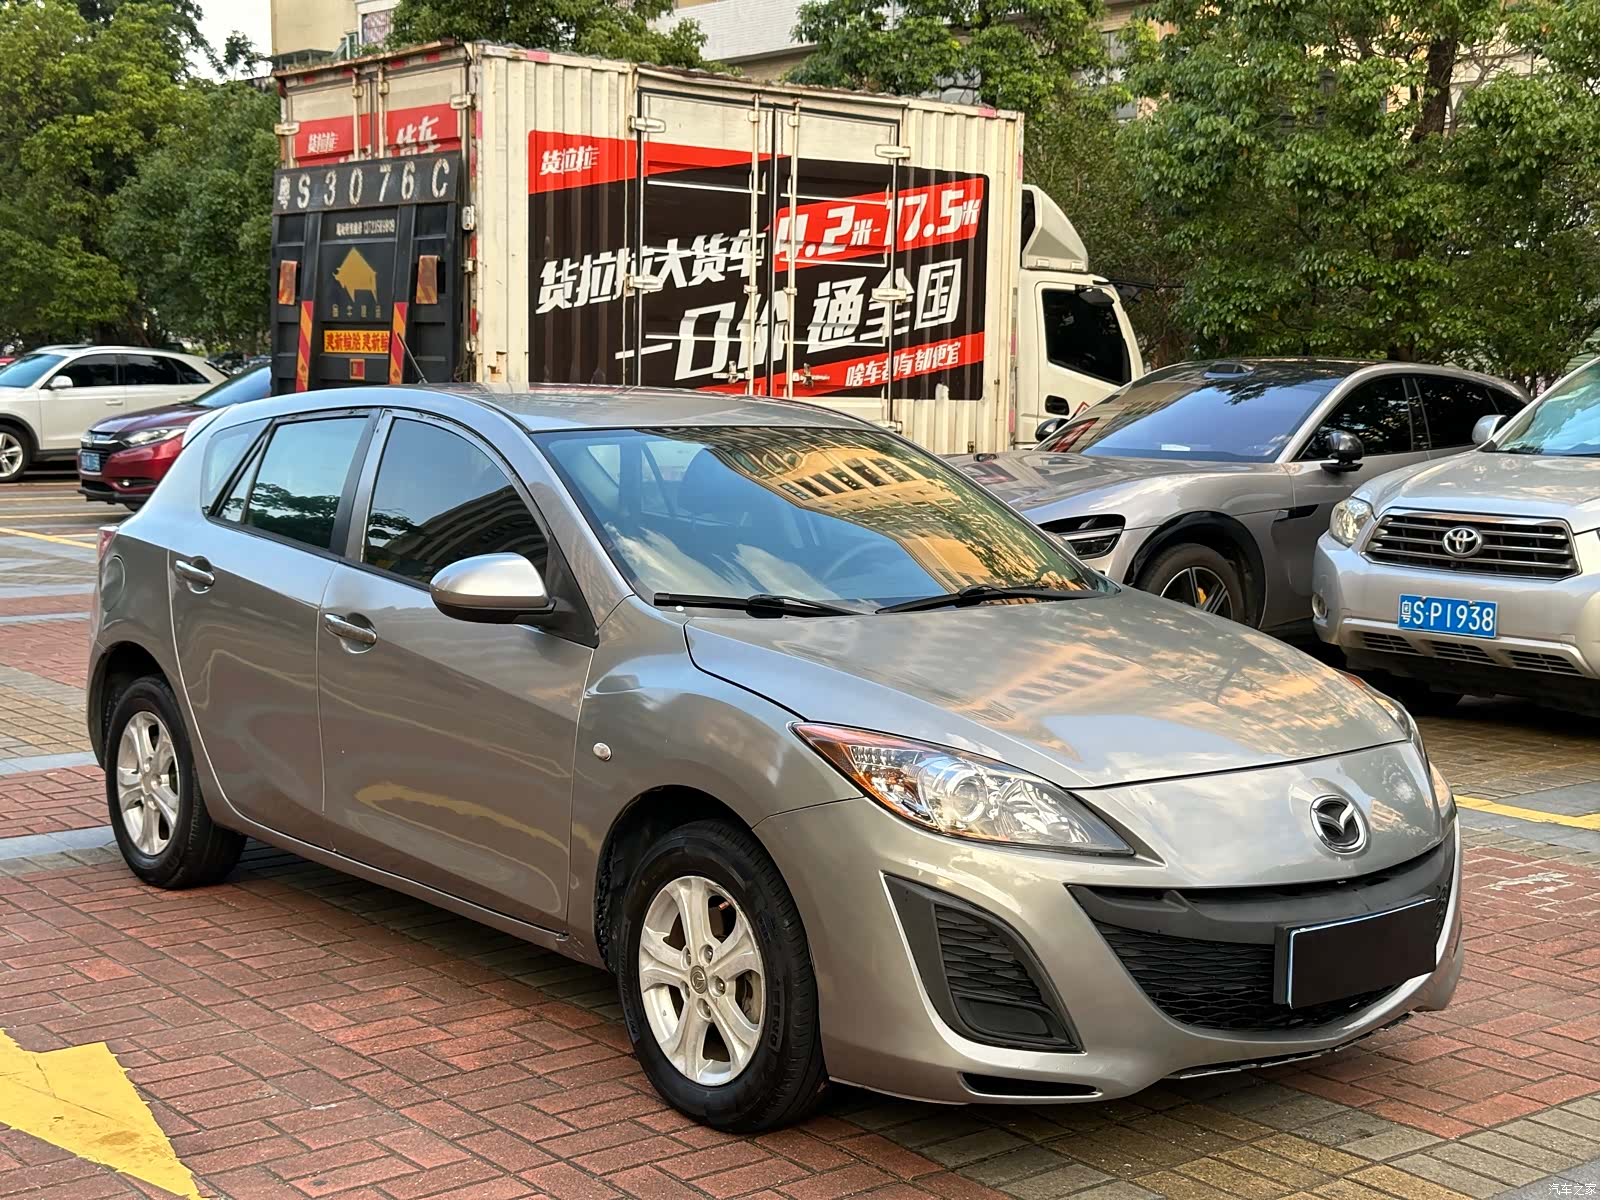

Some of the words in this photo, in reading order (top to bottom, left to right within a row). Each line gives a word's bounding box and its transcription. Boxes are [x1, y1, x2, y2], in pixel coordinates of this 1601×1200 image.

[539, 144, 600, 176] 货拉拉
[535, 228, 767, 314] 货拉拉大货车
[806, 258, 963, 354] 通全国
[845, 341, 961, 387] 啥车都有都便宜
